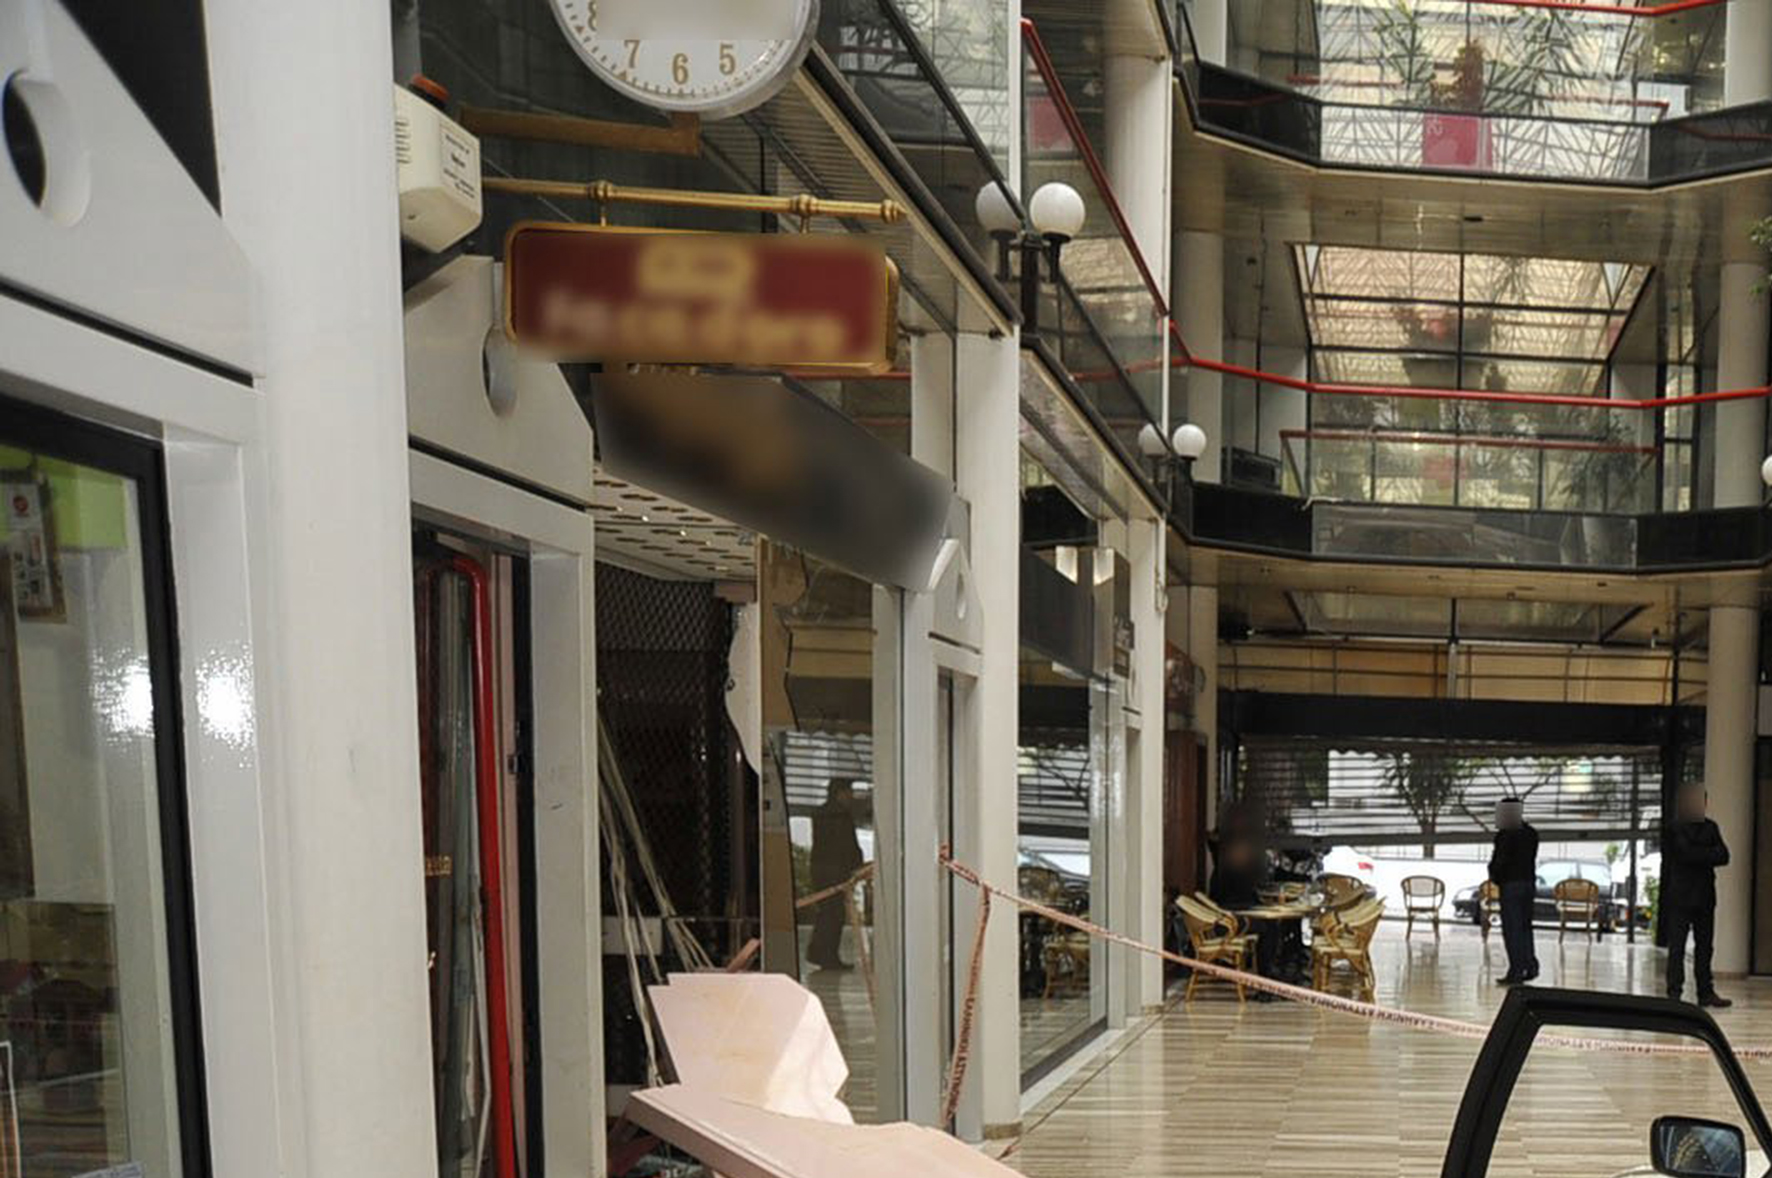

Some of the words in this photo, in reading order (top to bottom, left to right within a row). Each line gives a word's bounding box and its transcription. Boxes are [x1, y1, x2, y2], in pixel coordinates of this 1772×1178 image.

[623, 39, 641, 69] 7
[671, 53, 689, 85] 6
[718, 43, 736, 75] 5
